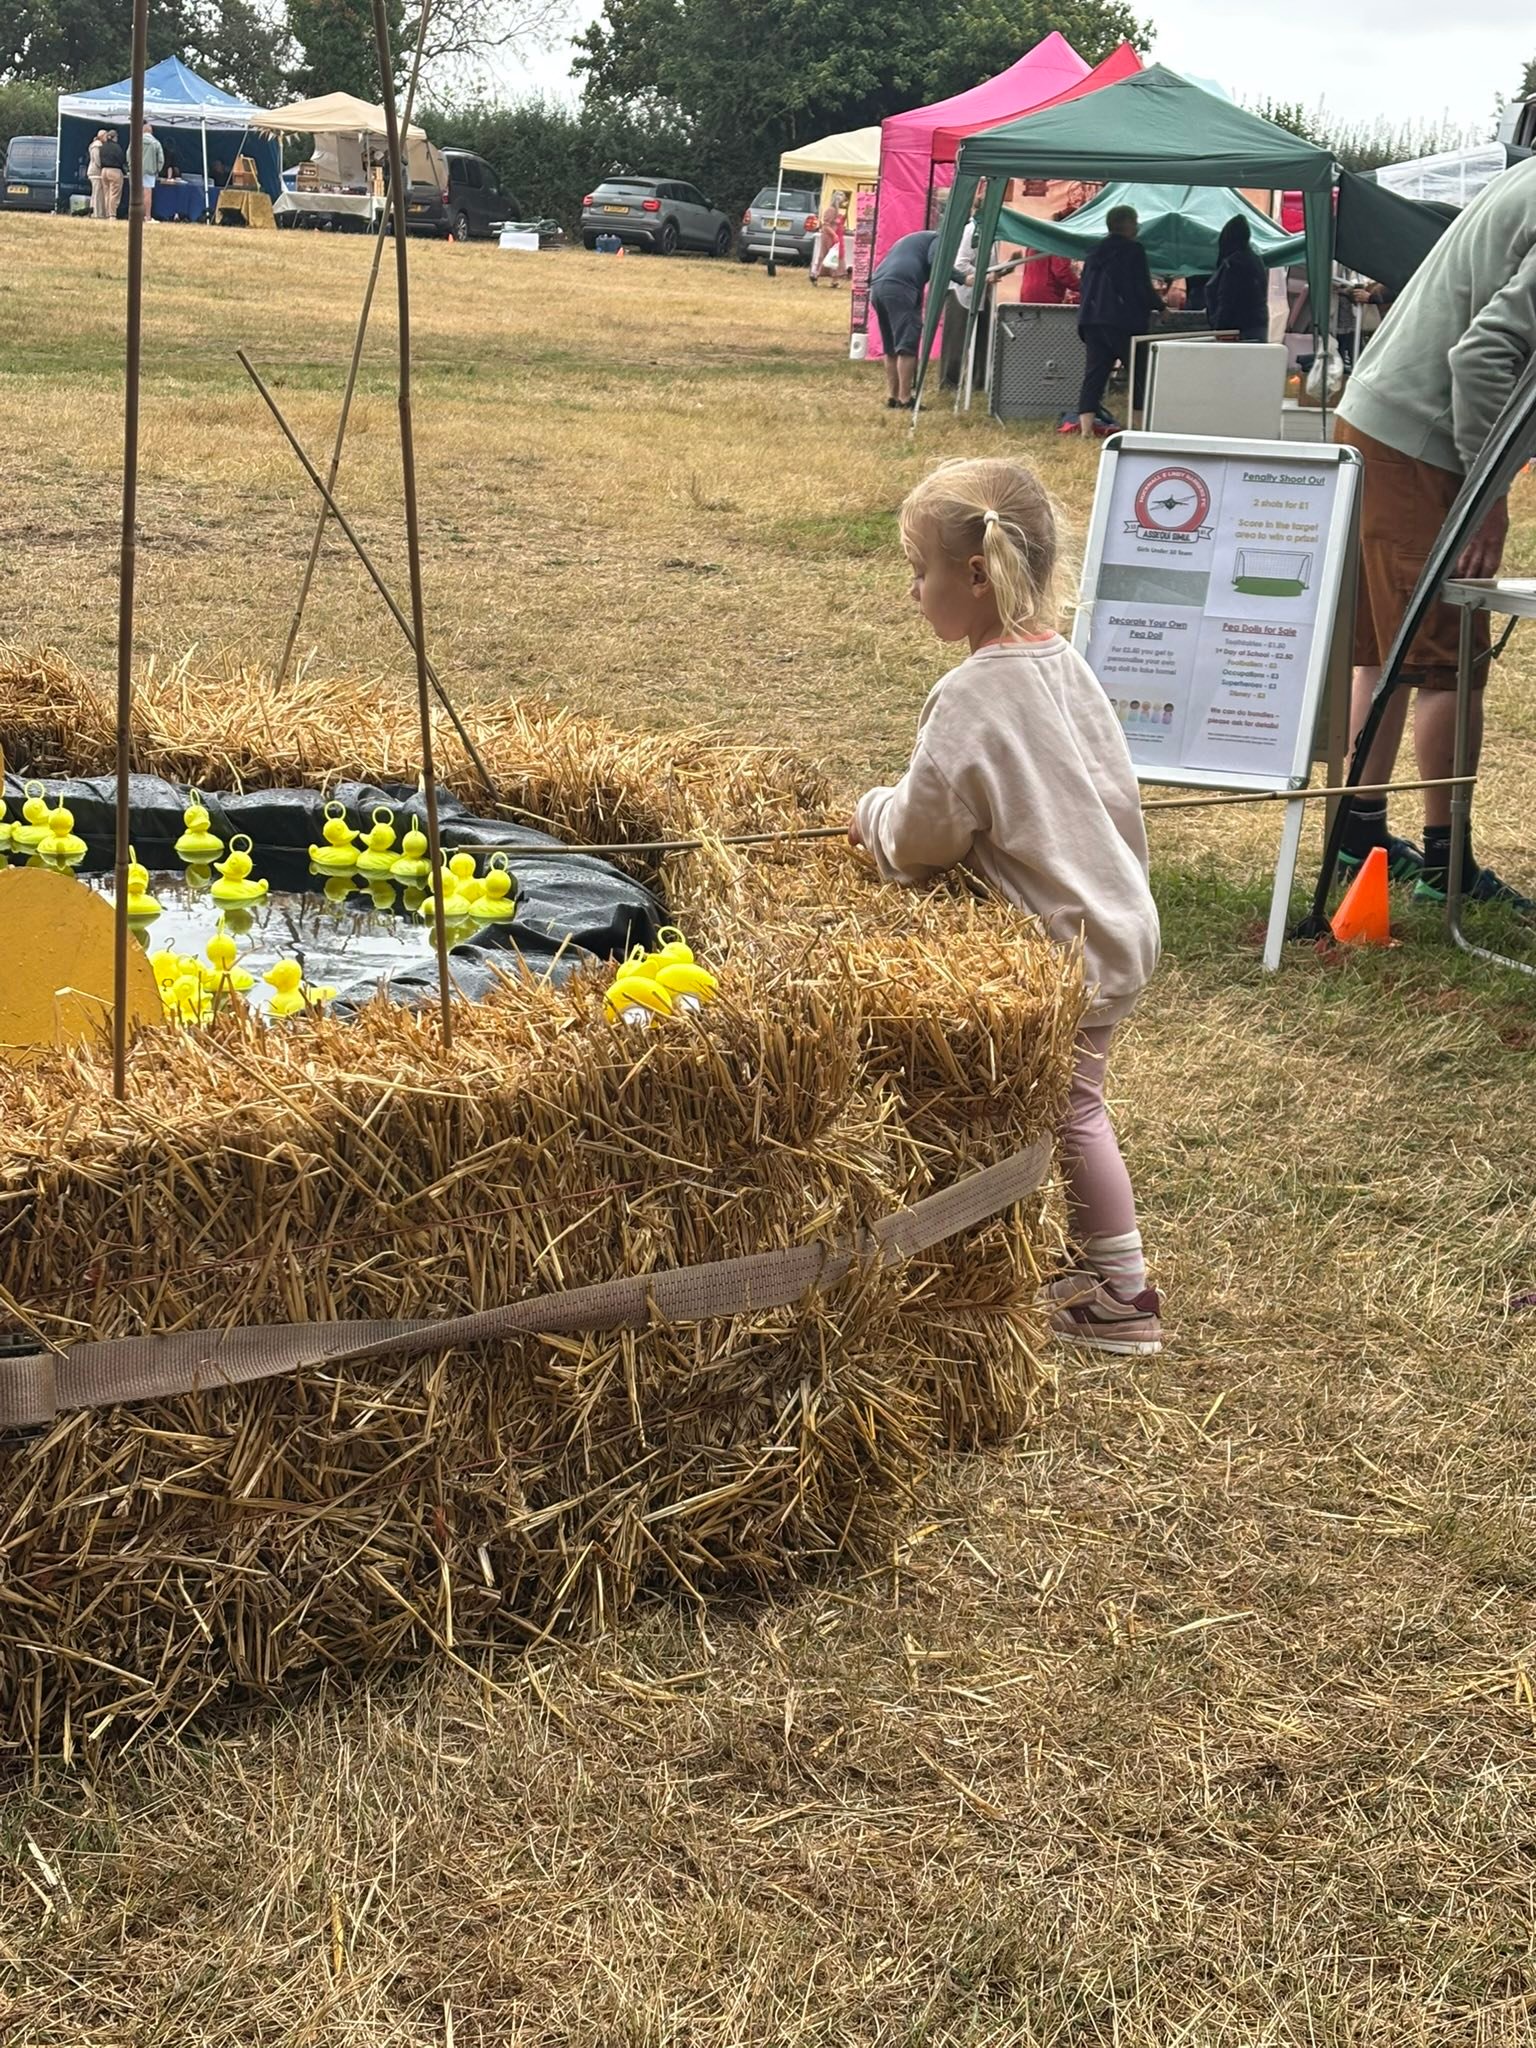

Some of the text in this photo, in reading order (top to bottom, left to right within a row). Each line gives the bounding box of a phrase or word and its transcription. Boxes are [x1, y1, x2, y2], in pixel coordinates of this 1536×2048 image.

[1243, 472, 1325, 486] Penalty Shoot Out
[1261, 500, 1283, 508] shots
[1285, 500, 1297, 508] for
[1238, 518, 1264, 528] Score
[1276, 520, 1290, 529] the
[1292, 522, 1318, 532] target
[1235, 531, 1256, 539] area
[1108, 616, 1188, 629] Decorate Your Own
[1242, 624, 1262, 634] Dolls
[1264, 625, 1276, 634] for
[1278, 627, 1297, 636] Sale
[1147, 631, 1163, 640] Doll
[1222, 669, 1264, 678] Occupations
